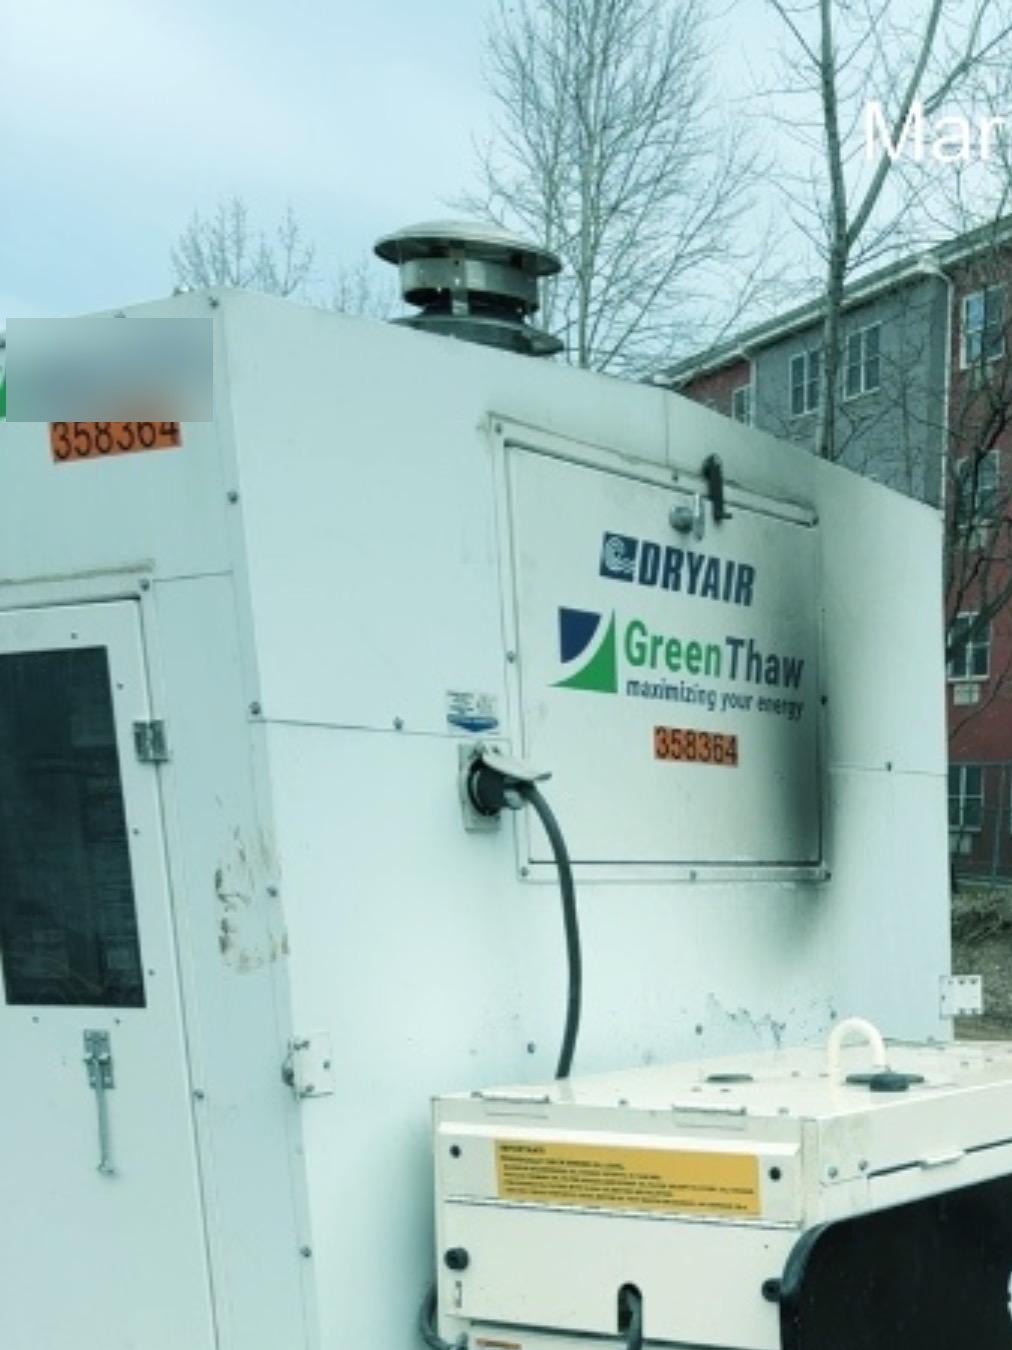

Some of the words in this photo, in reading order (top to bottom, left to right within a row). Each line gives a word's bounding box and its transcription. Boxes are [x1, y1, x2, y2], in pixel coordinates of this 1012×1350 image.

[52, 422, 180, 460] 358364
[637, 540, 756, 607] DRYAIR
[626, 677, 717, 712] maximizing
[721, 692, 754, 713] your
[757, 697, 805, 720] energy
[655, 725, 738, 768] 358364
